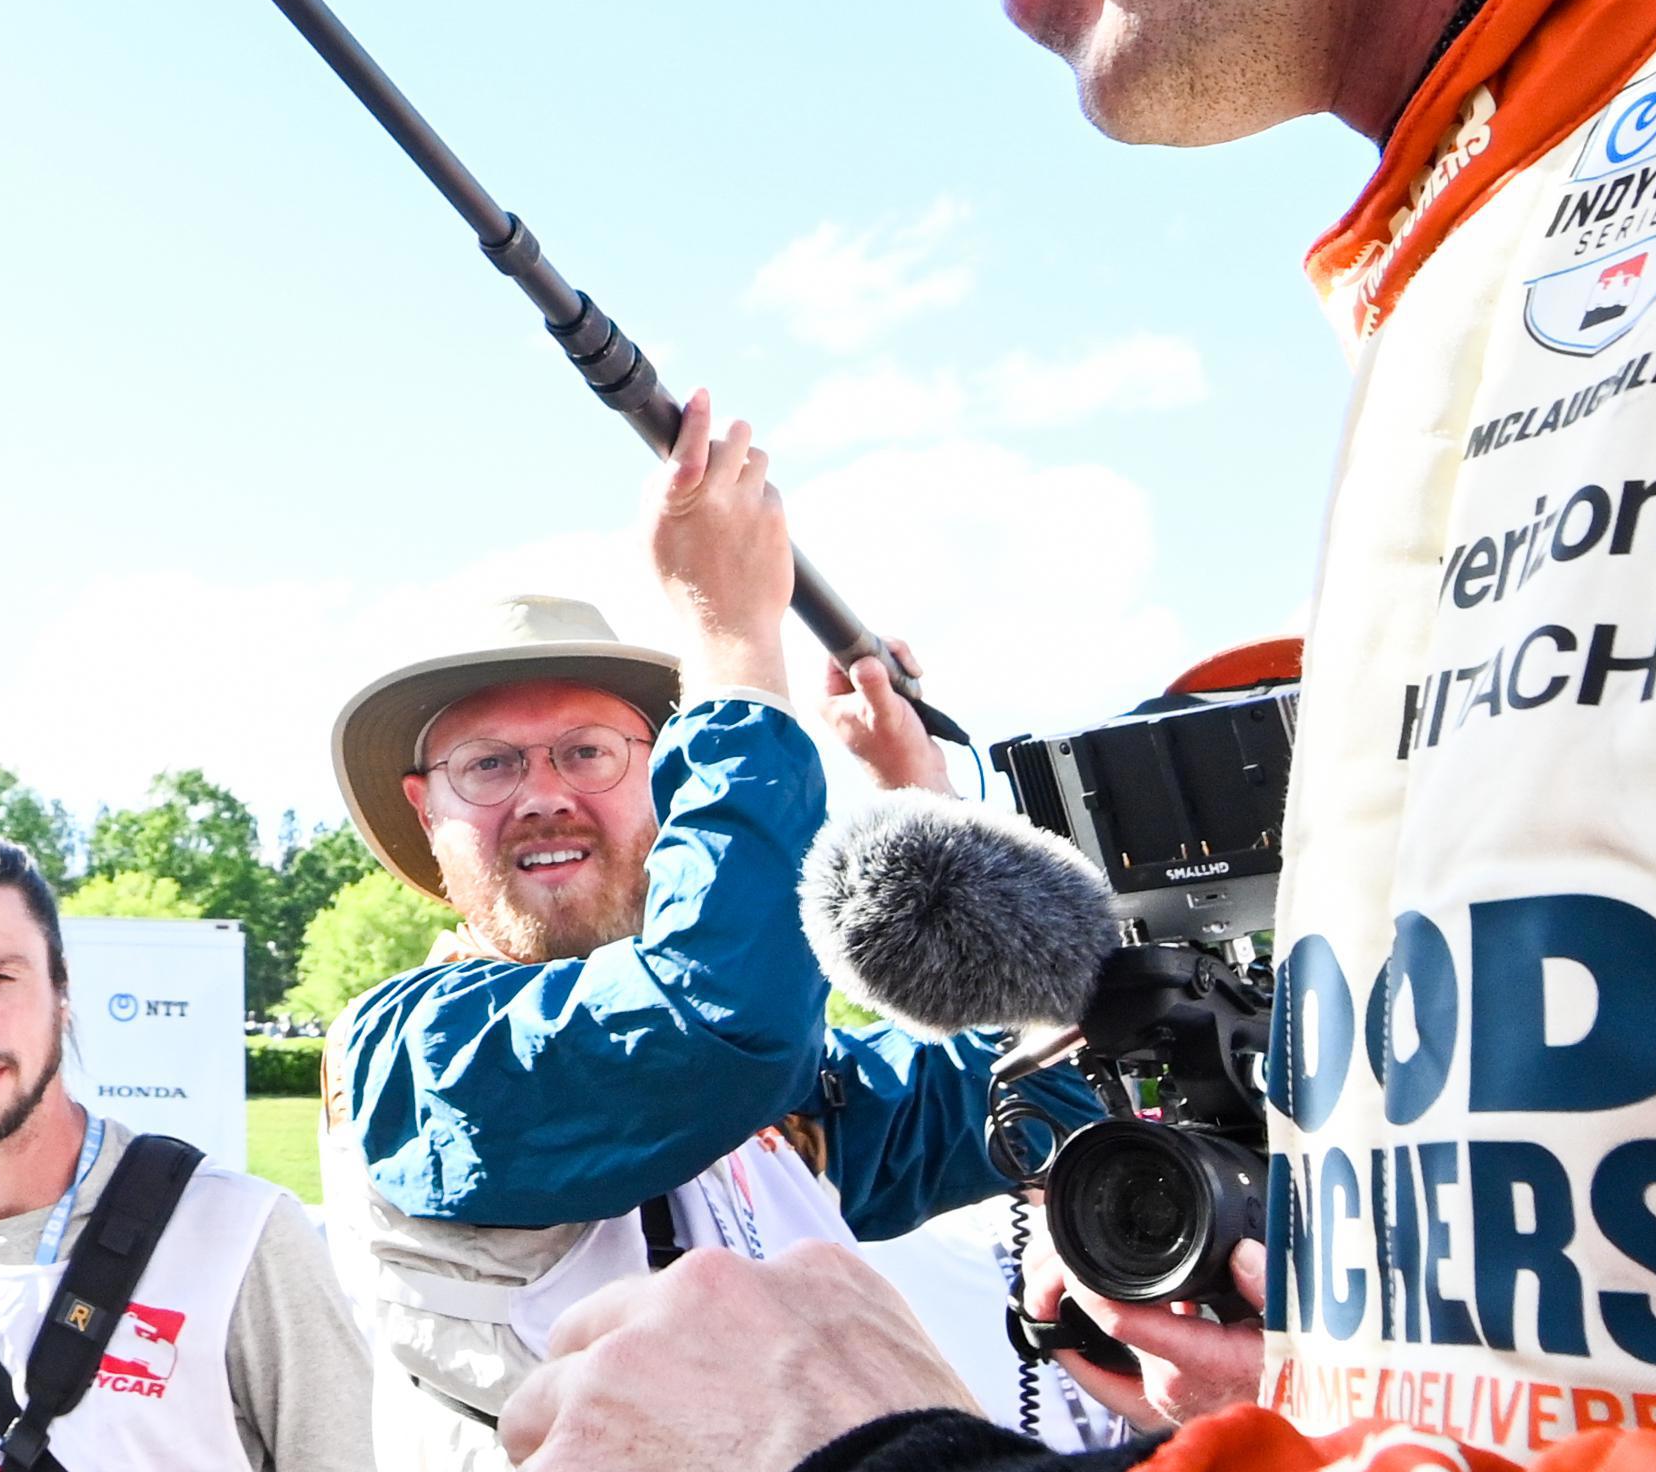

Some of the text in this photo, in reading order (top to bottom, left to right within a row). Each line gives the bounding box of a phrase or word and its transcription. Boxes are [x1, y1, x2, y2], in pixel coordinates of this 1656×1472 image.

[1165, 861, 1230, 880] SMALLHD
[146, 1000, 189, 1017] NTT
[98, 1084, 188, 1099] HONDA
